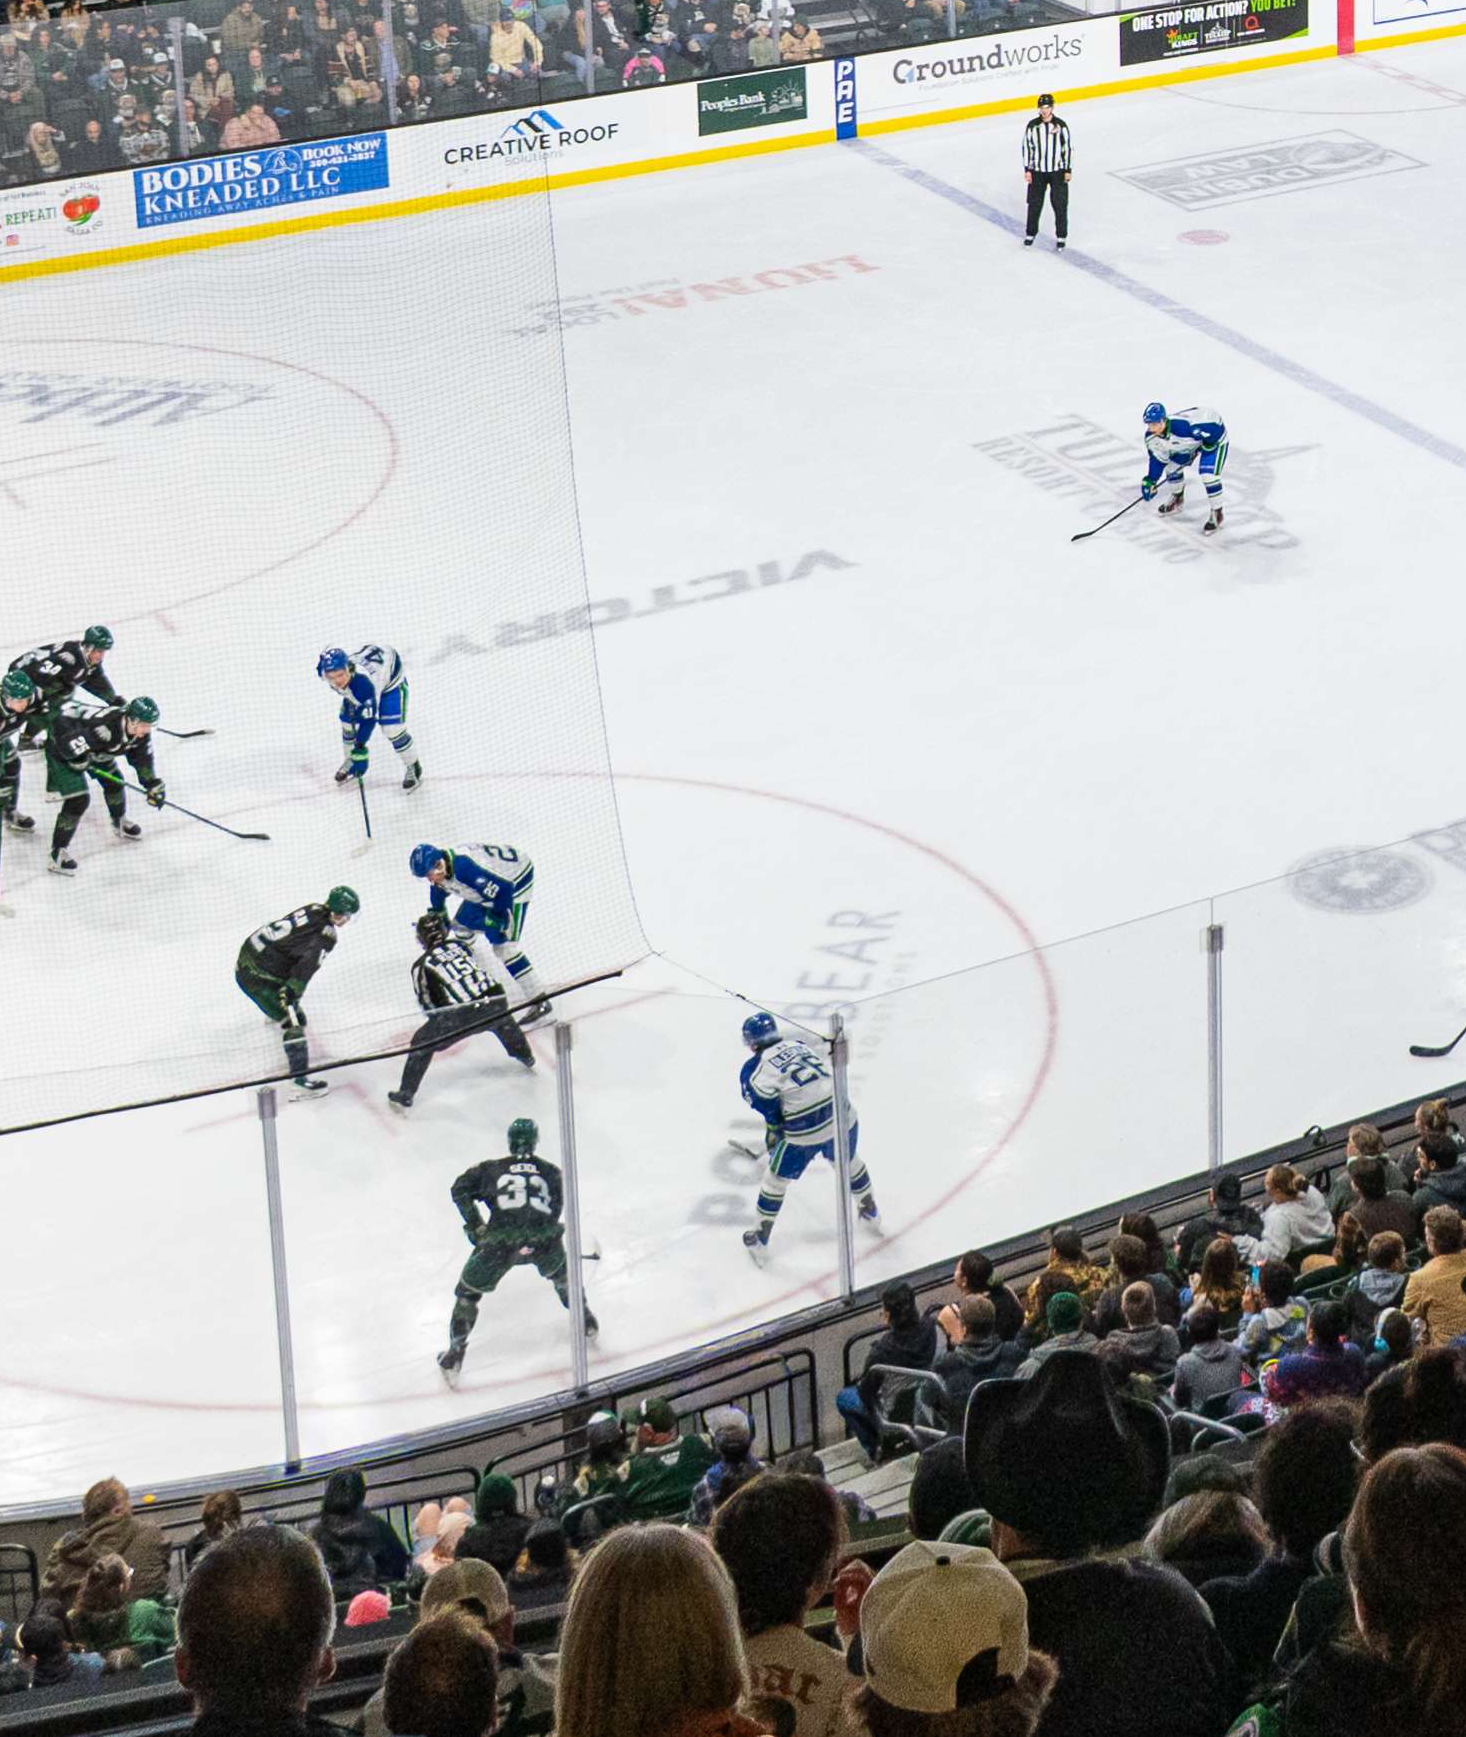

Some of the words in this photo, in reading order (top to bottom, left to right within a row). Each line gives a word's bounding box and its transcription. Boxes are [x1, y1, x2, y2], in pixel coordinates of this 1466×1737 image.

[1132, 16, 1154, 32] ONE
[1156, 11, 1183, 29] STOP
[1184, 7, 1205, 23] FOR
[1206, 0, 1249, 20] ACTION?
[893, 34, 1082, 85] Groundworks
[701, 96, 739, 112] Peoples
[740, 91, 766, 105] Bank
[302, 146, 345, 161] BOOK
[348, 138, 382, 152] NOW
[444, 133, 551, 165] CREATIVE
[559, 123, 619, 147] ROOF
[141, 155, 262, 194] BODIES
[144, 178, 280, 215] KNEADED
[291, 167, 341, 192] LLC
[416, 550, 864, 668] VICTORY
